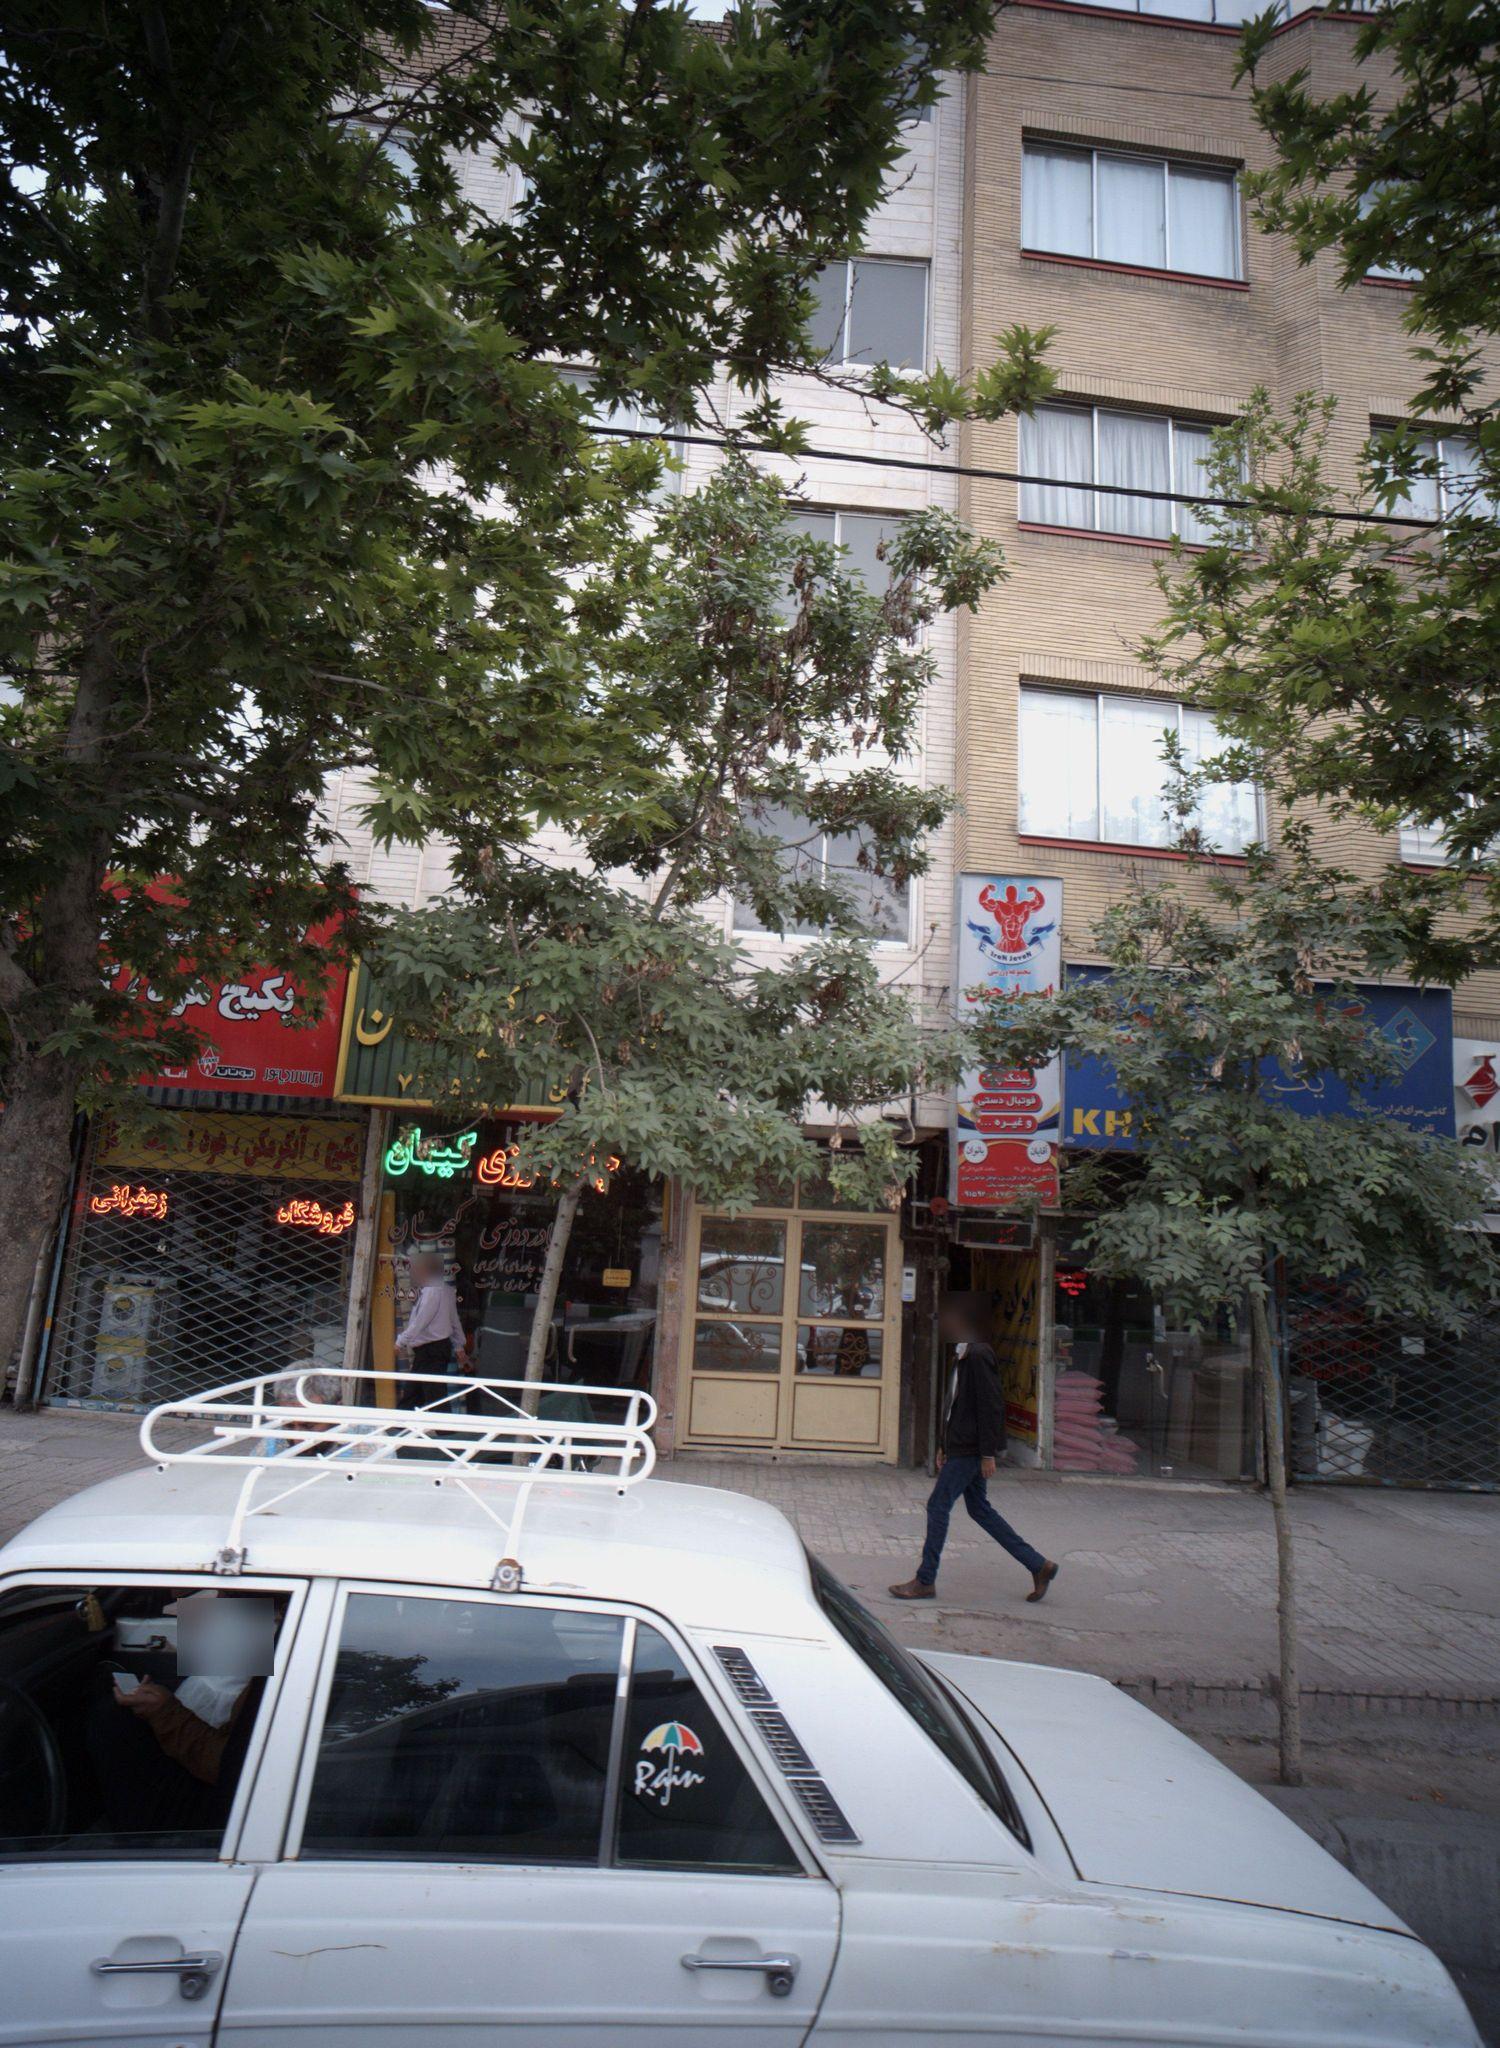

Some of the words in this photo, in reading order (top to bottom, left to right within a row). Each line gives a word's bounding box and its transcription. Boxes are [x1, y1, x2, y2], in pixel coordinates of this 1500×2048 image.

[217, 975, 296, 1027] پکیج
[217, 1067, 254, 1078] بوتان
[977, 1094, 1005, 1106] دستی
[1005, 1095, 1038, 1107] فوتبال
[994, 1117, 1023, 1130] غیره
[384, 1126, 479, 1179] کیهان
[91, 1185, 169, 1219] زعفرانی
[634, 1760, 705, 1797] Rain
